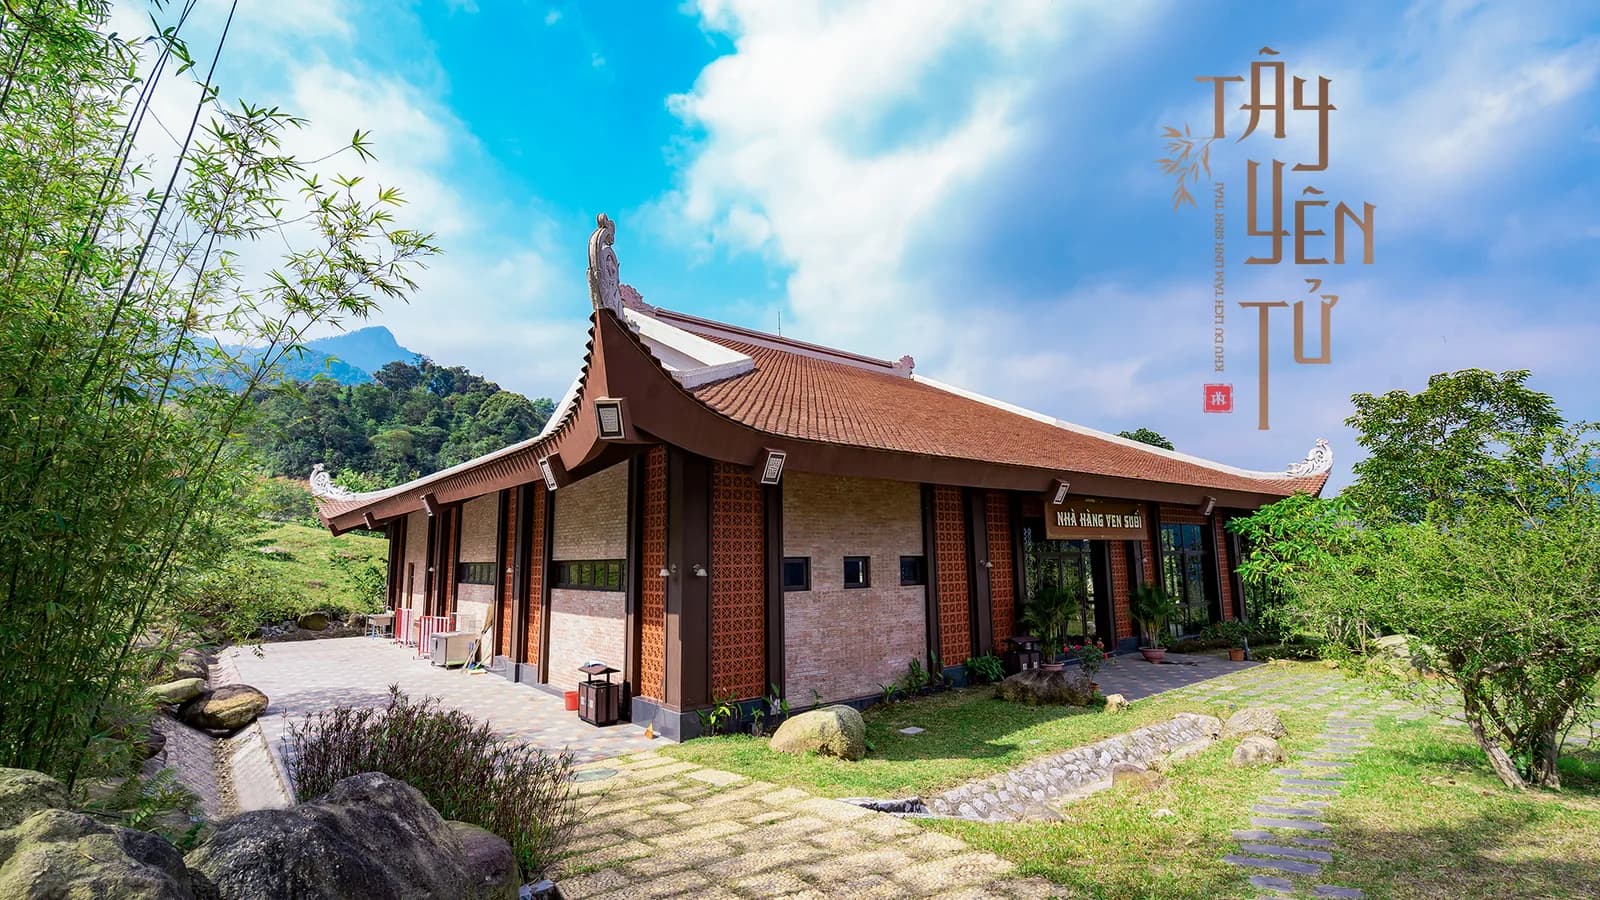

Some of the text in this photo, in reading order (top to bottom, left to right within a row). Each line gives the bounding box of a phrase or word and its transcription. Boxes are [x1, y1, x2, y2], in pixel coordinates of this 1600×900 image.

[1057, 508, 1078, 527] NHÀ
[1079, 508, 1104, 528] HÀNG
[1105, 514, 1122, 528] VEN
